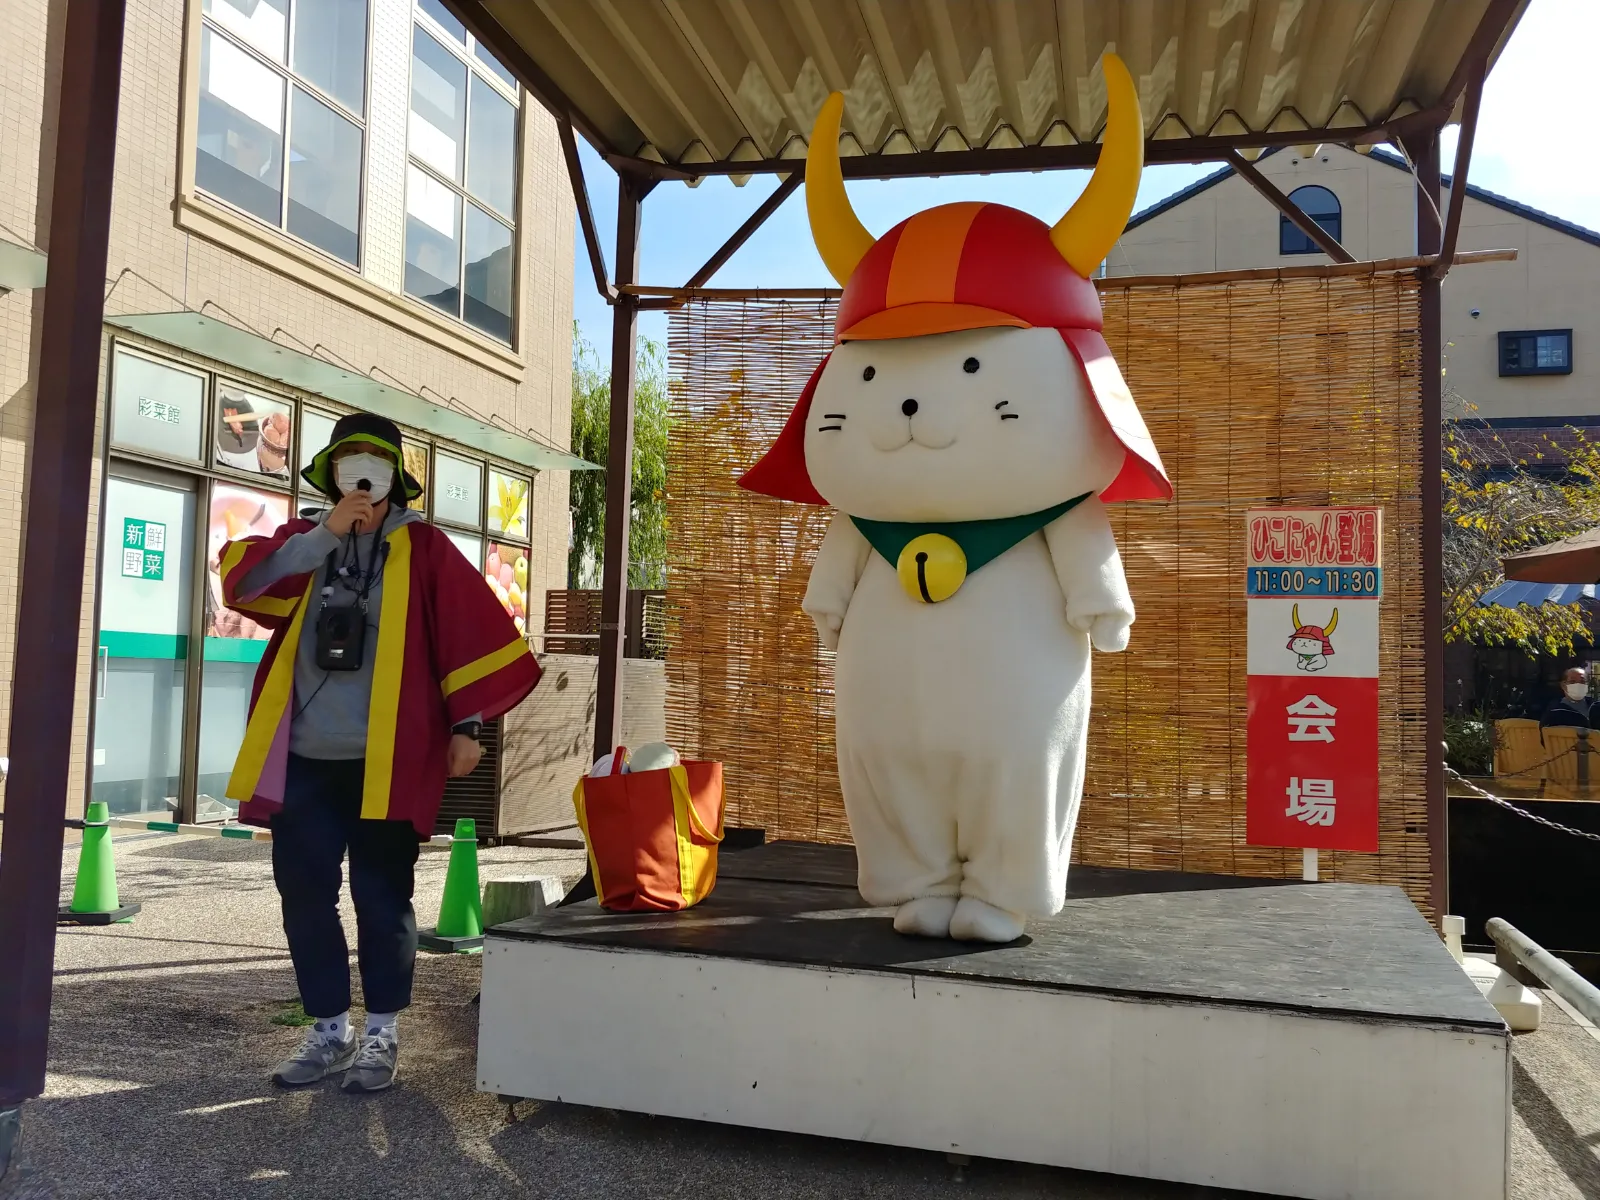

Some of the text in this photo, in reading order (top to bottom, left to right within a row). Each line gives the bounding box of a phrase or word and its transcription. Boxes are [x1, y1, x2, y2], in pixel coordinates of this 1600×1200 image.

[139, 397, 180, 424] 彩菜館
[125, 523, 163, 548] 新鮮
[1250, 511, 1377, 567] ひこにゃん登場
[125, 551, 162, 575] 野菜
[1285, 694, 1338, 827] 会場
